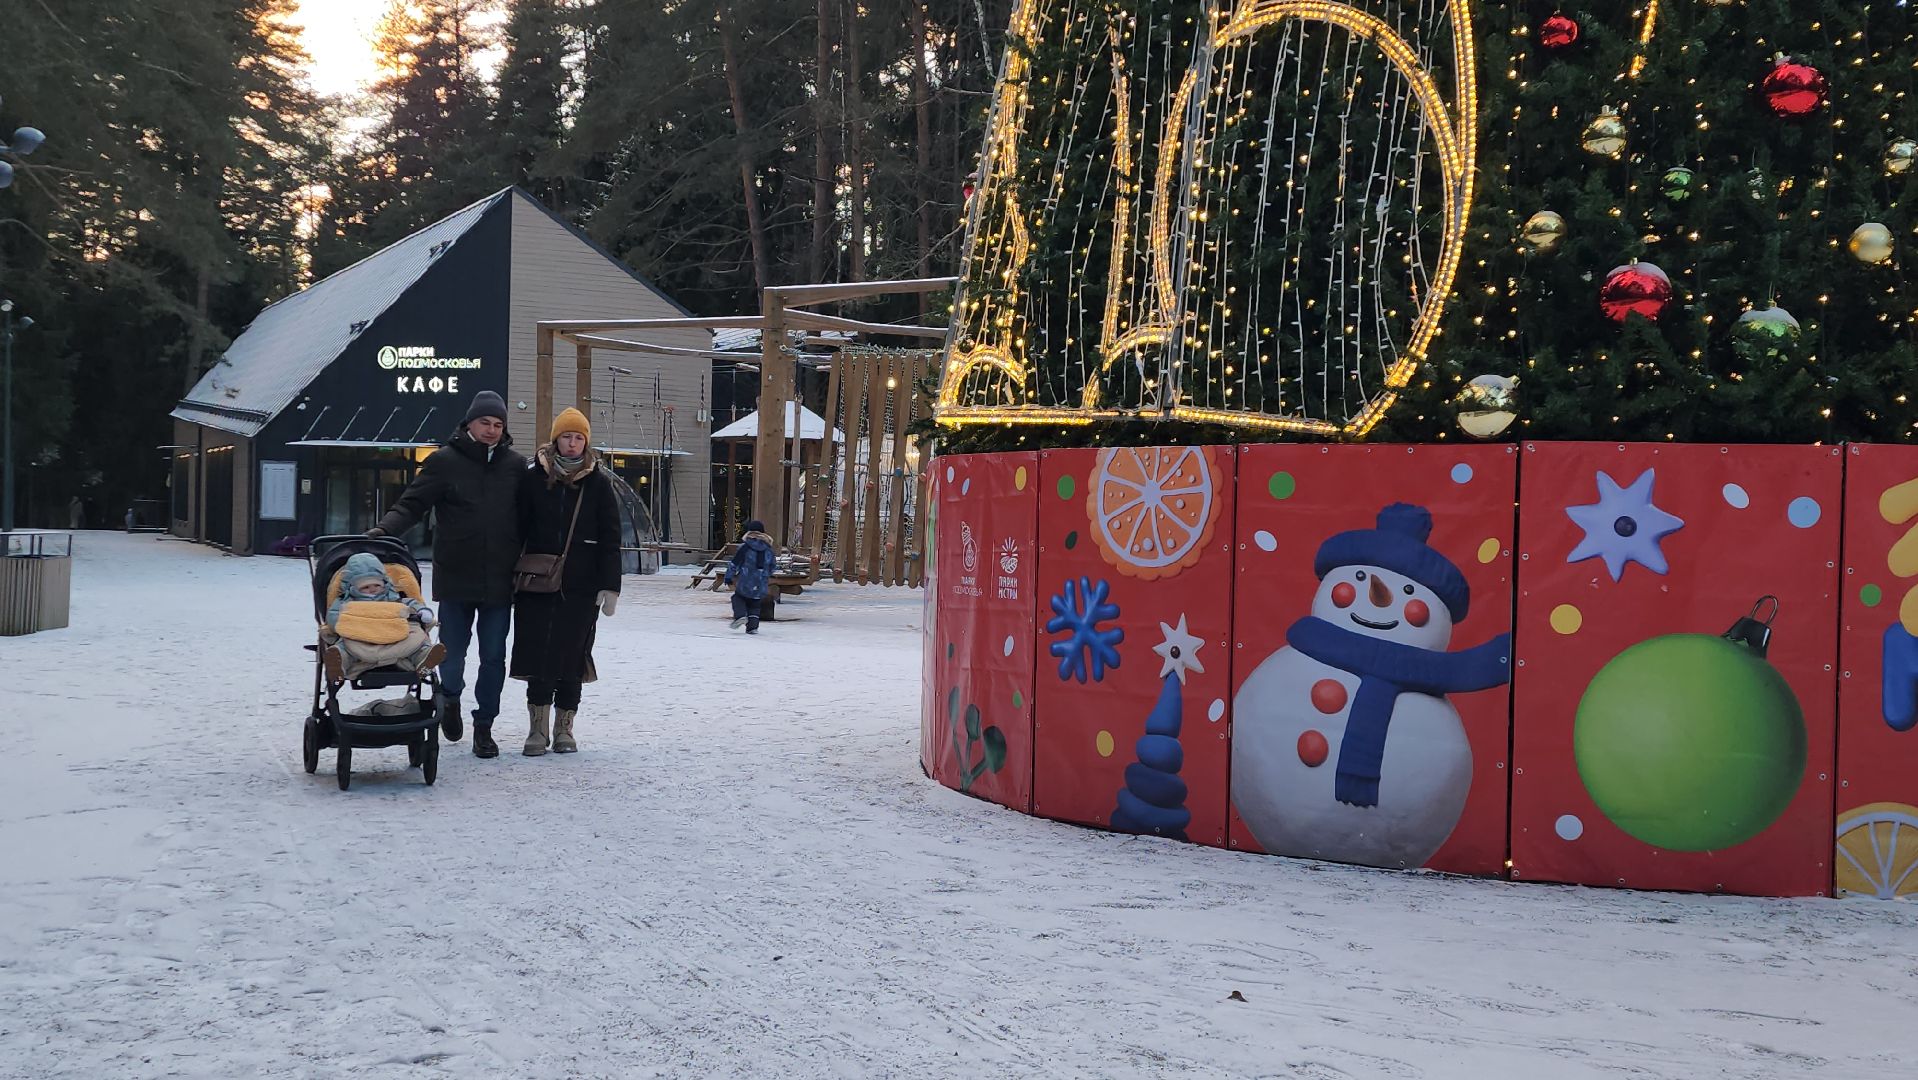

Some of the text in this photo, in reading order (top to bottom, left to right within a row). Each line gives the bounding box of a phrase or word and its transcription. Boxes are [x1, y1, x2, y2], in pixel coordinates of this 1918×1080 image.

[398, 347, 435, 358] ПАРКИ
[398, 358, 481, 369] ПОДМОСКОВЬЯ
[397, 376, 459, 393] КАФЕ
[999, 576, 1018, 588] ПАРКИ
